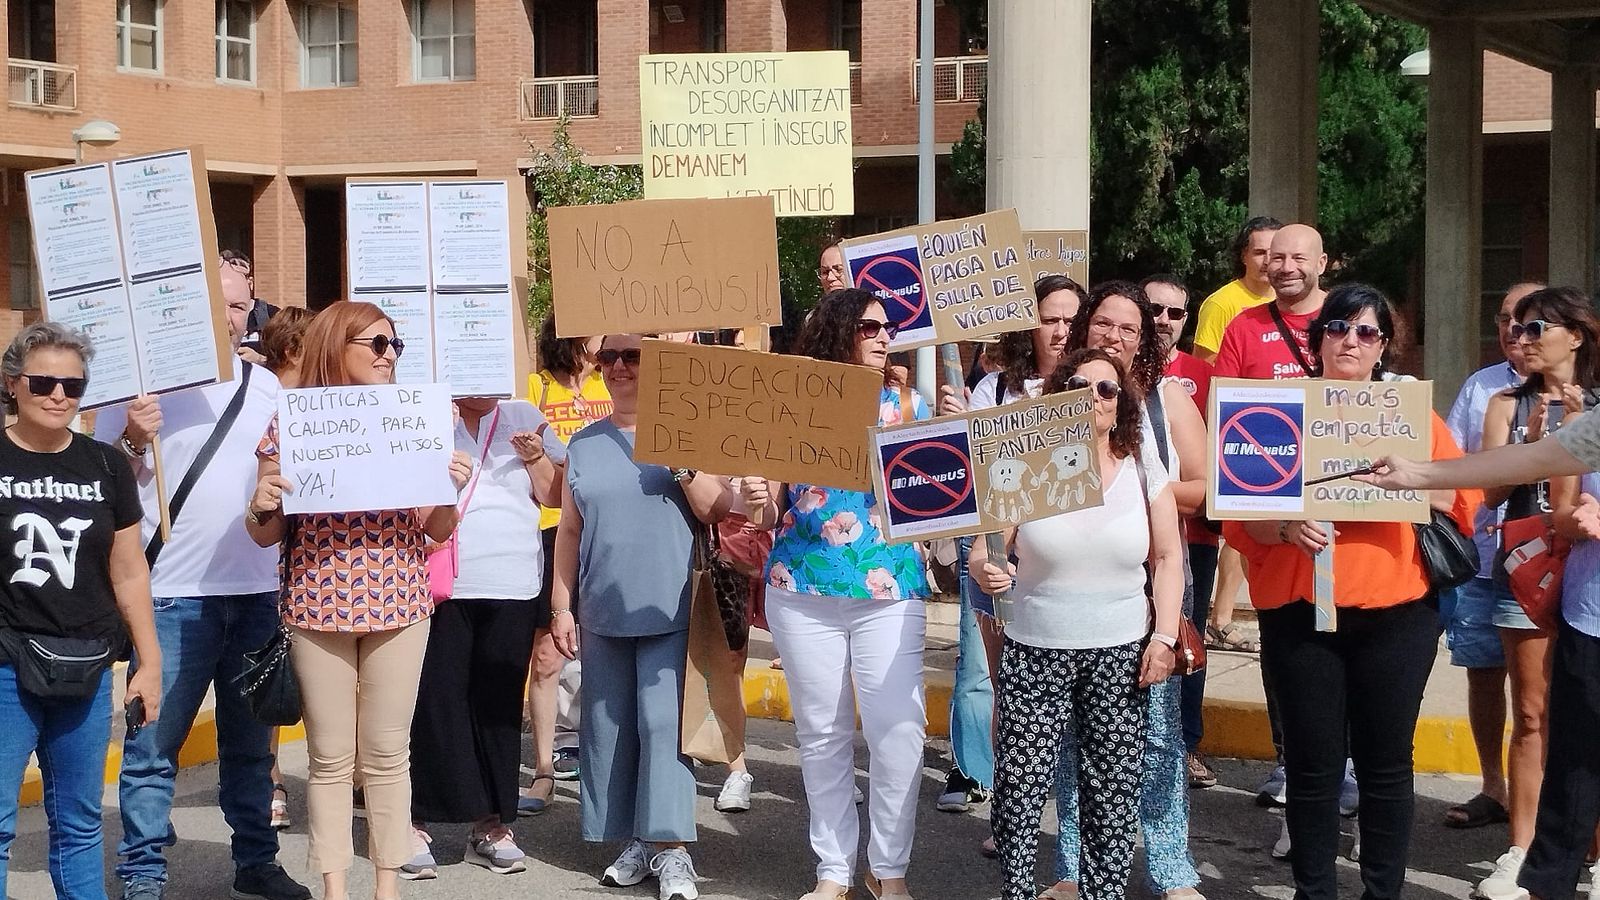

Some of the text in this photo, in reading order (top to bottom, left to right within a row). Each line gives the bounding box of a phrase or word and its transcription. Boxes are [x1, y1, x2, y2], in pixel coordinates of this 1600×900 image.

[645, 59, 783, 85] TRANSPORT
[689, 88, 850, 115] DESORGANITZAT
[652, 153, 747, 179] DEMANEM
[576, 218, 693, 272] NO A
[922, 223, 988, 260] ¿QUIÉN
[930, 247, 1019, 287] PAGA LA
[600, 263, 772, 321] MONBUS!!
[934, 282, 984, 311] SILLA
[991, 275, 1025, 298] DE
[954, 298, 1034, 331] VÍCTOR?
[287, 388, 423, 415] POLÍTICAS DE
[1324, 384, 1400, 408] más
[288, 416, 426, 438] CALIDAD, PARA
[971, 397, 1093, 440] ADMINISTRACIÓN
[1311, 413, 1417, 445] empatía
[292, 437, 443, 463] NUESTROS HIJOS
[650, 424, 697, 453] DE
[974, 421, 1092, 465] FANTASMA
[296, 469, 336, 499] YA!
